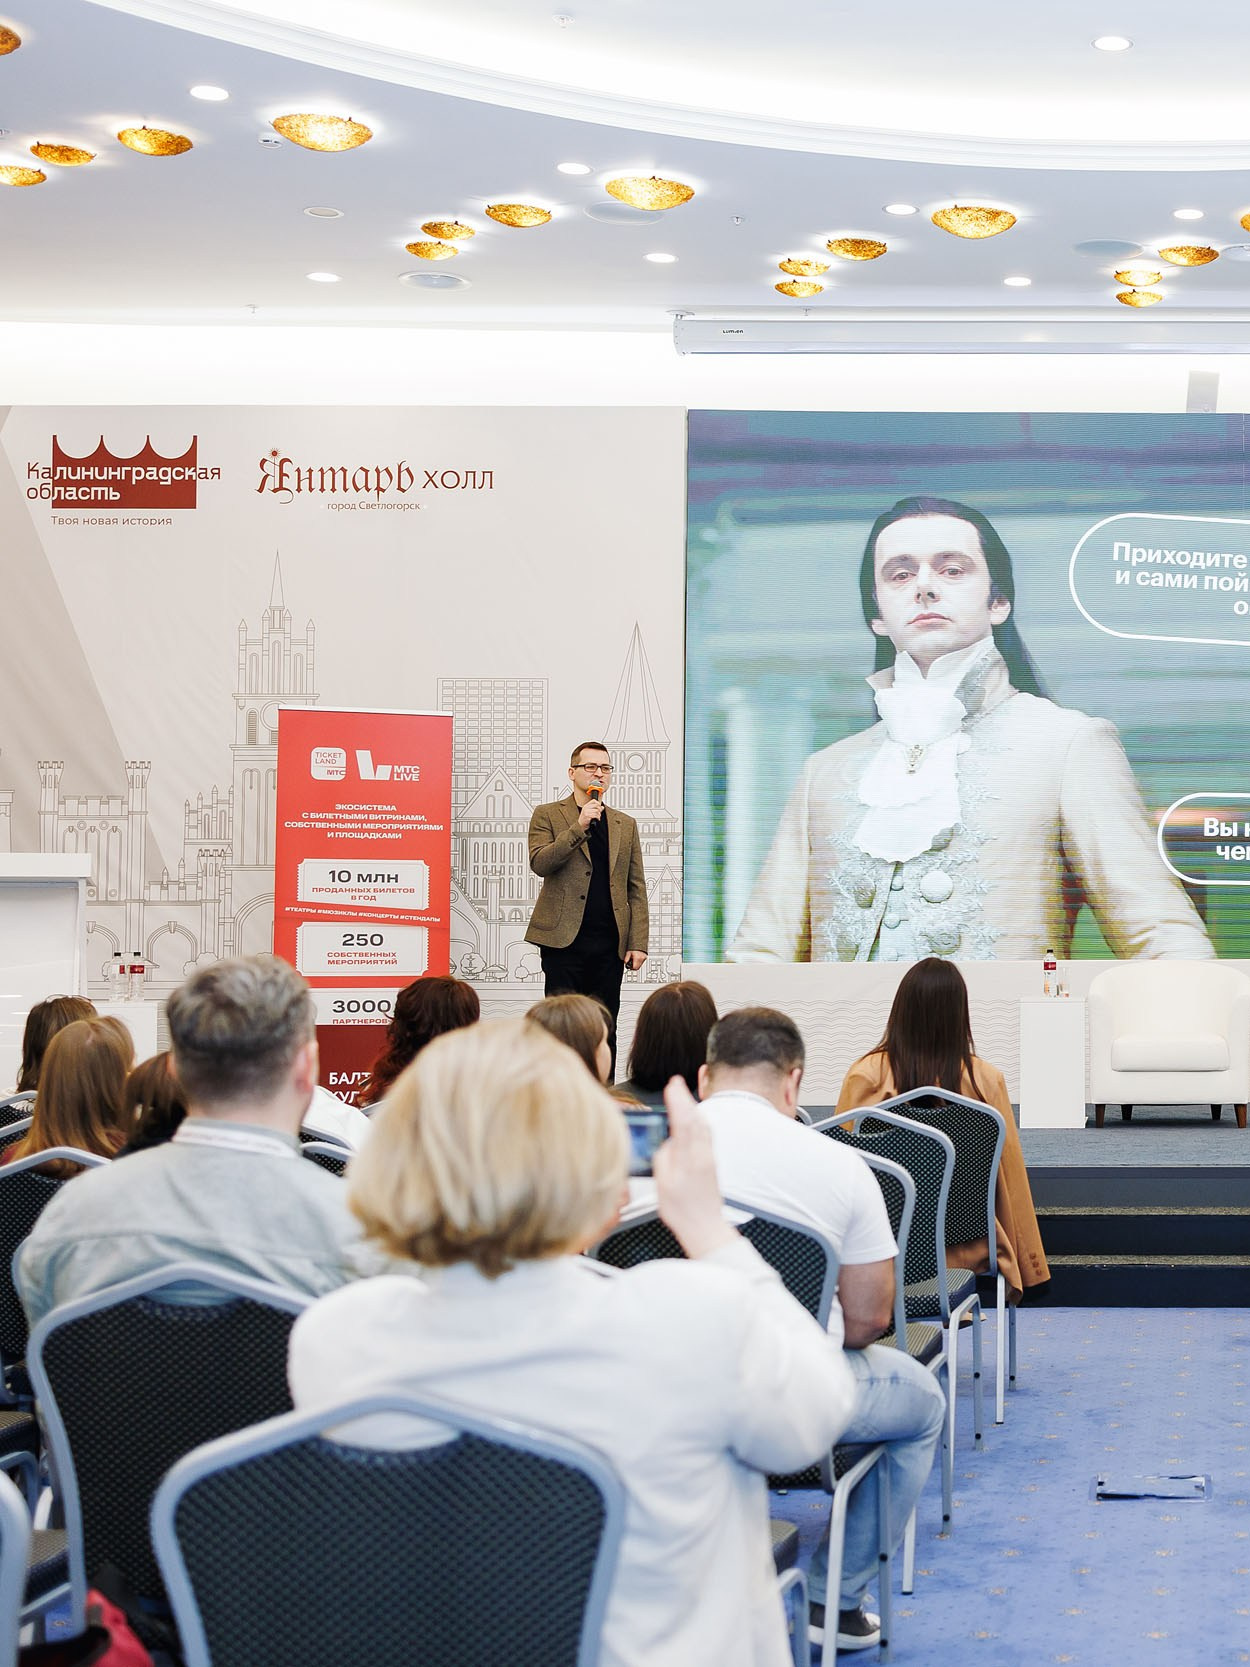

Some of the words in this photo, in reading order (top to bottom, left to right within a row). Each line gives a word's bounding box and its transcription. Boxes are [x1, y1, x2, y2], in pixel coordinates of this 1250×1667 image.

[27, 461, 221, 485] Калининградская
[255, 452, 415, 504] Янтарь
[26, 483, 121, 500] область
[327, 502, 356, 511] город
[359, 501, 420, 511] Светлогорск
[51, 516, 79, 525] Твоя
[83, 517, 118, 525] новая
[122, 517, 172, 526] история
[1112, 541, 1248, 569] Приходите
[1115, 569, 1130, 584] и
[1136, 569, 1198, 588] сами
[362, 823, 443, 831] МЕРОПРИЯТИЯМИ
[1203, 818, 1237, 837] Вы
[329, 870, 351, 883] 10
[357, 874, 399, 883] млн
[359, 911, 399, 919] #КОНЦЕРТЫ
[342, 934, 384, 946] 250
[332, 1000, 391, 1013] 3000
